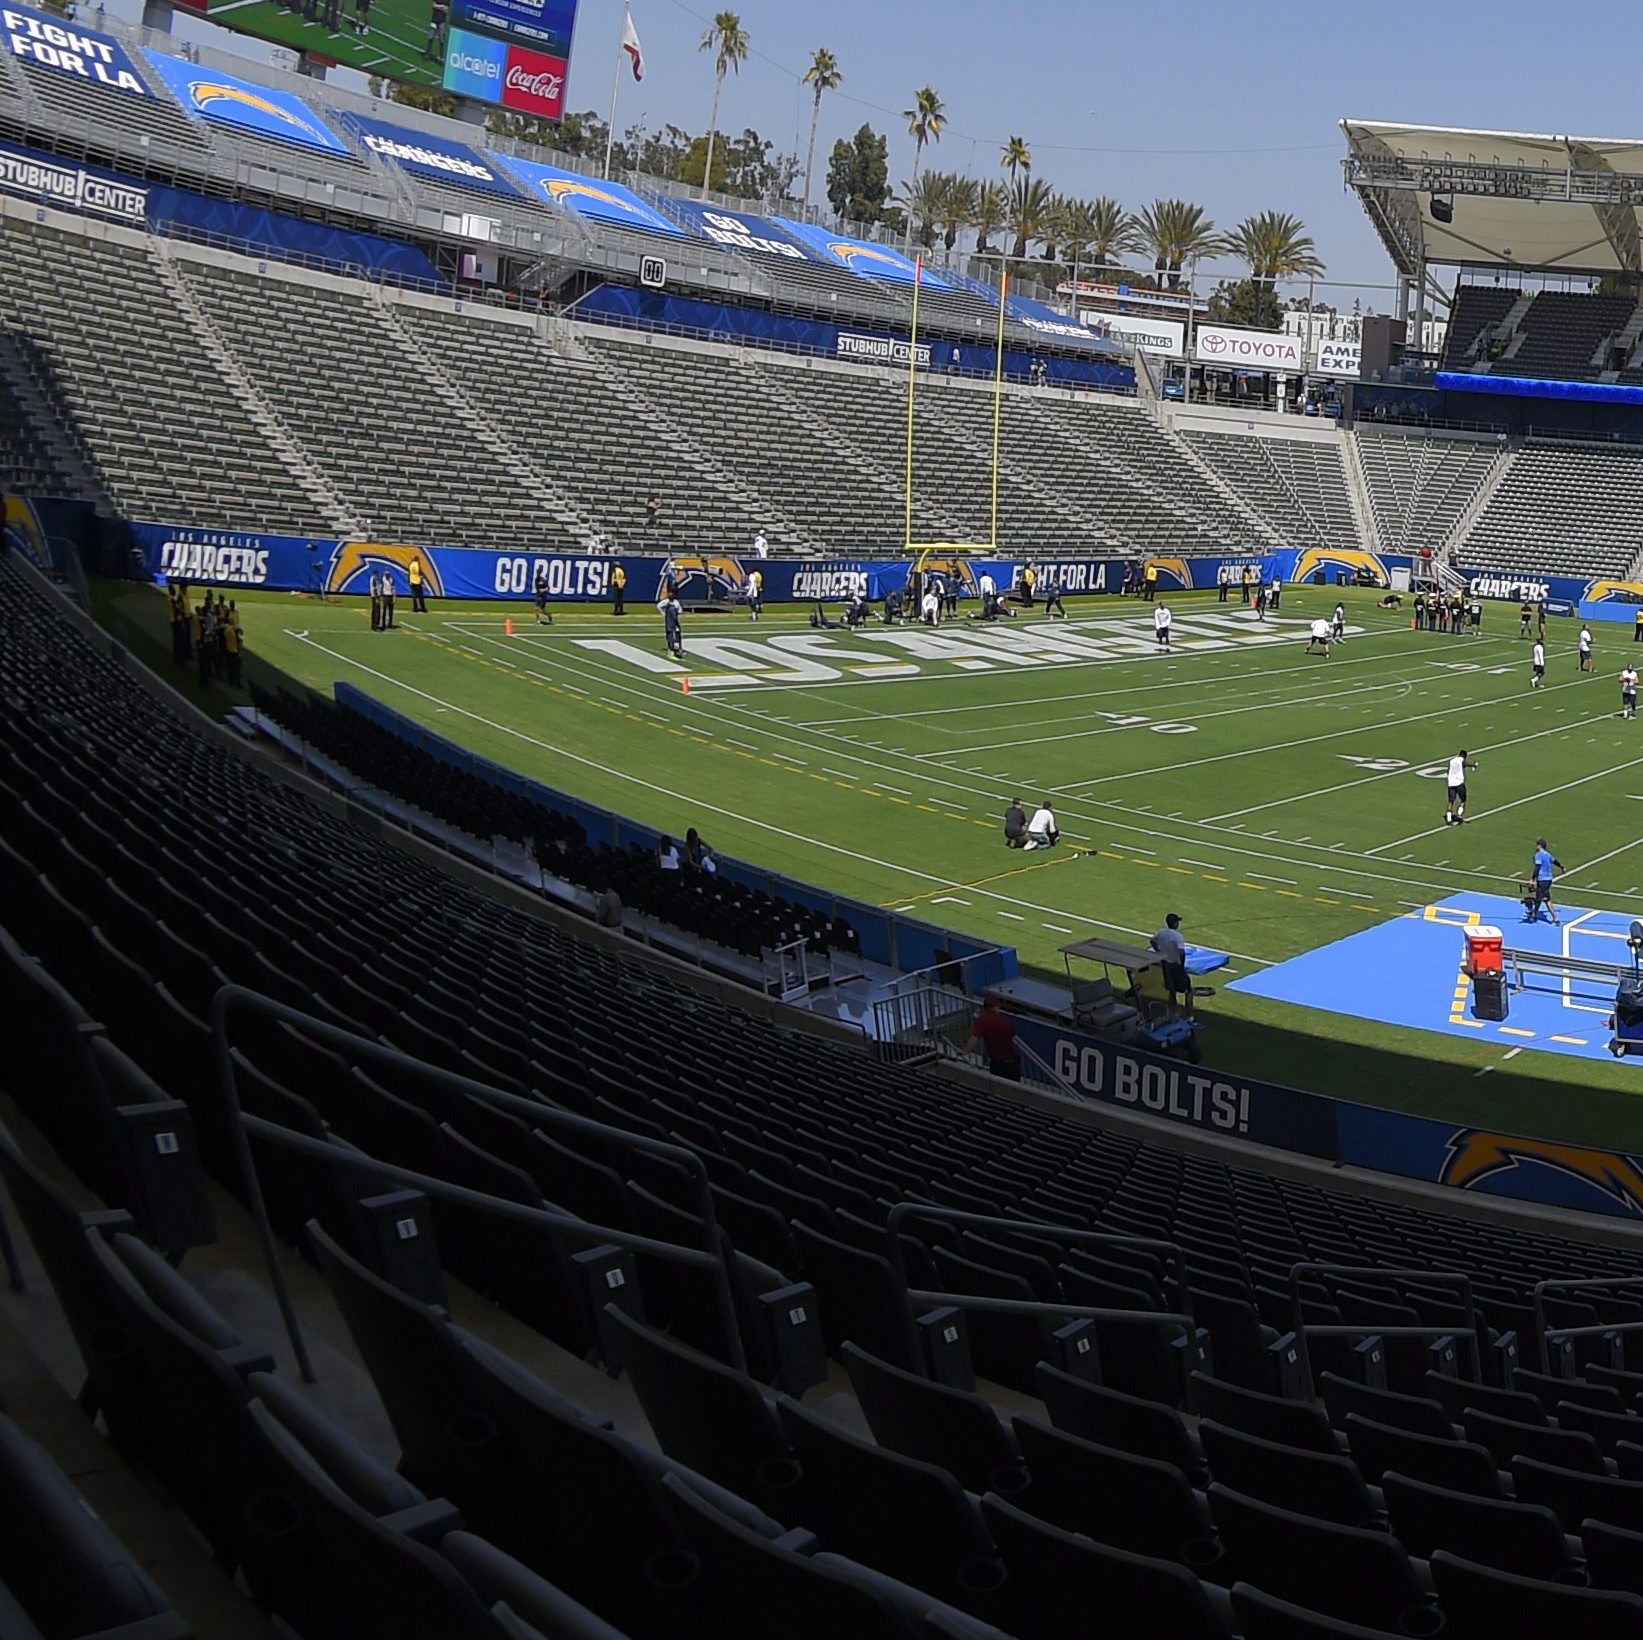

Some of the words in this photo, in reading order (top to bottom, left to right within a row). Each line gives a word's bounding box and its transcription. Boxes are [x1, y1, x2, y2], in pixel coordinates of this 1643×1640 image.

[4, 10, 114, 64] FIGHT
[10, 33, 90, 76] FOR
[94, 61, 146, 94] LA
[450, 52, 500, 79] alcatel
[84, 184, 146, 215] CENTER
[703, 211, 750, 234] GO
[1136, 334, 1171, 348] KINGS
[1229, 339, 1297, 360] TOYOTA
[1320, 357, 1363, 371] EXP
[171, 531, 196, 543] LOS
[202, 534, 260, 549] ANGELES
[161, 541, 269, 584] CHARGERS
[494, 557, 528, 594] GO
[792, 572, 869, 598] CHARGERS
[1060, 565, 1084, 591] FOR
[1087, 563, 1107, 590] LA
[1055, 1038, 1104, 1093] GO
[1114, 1054, 1252, 1133] BOLTS!
